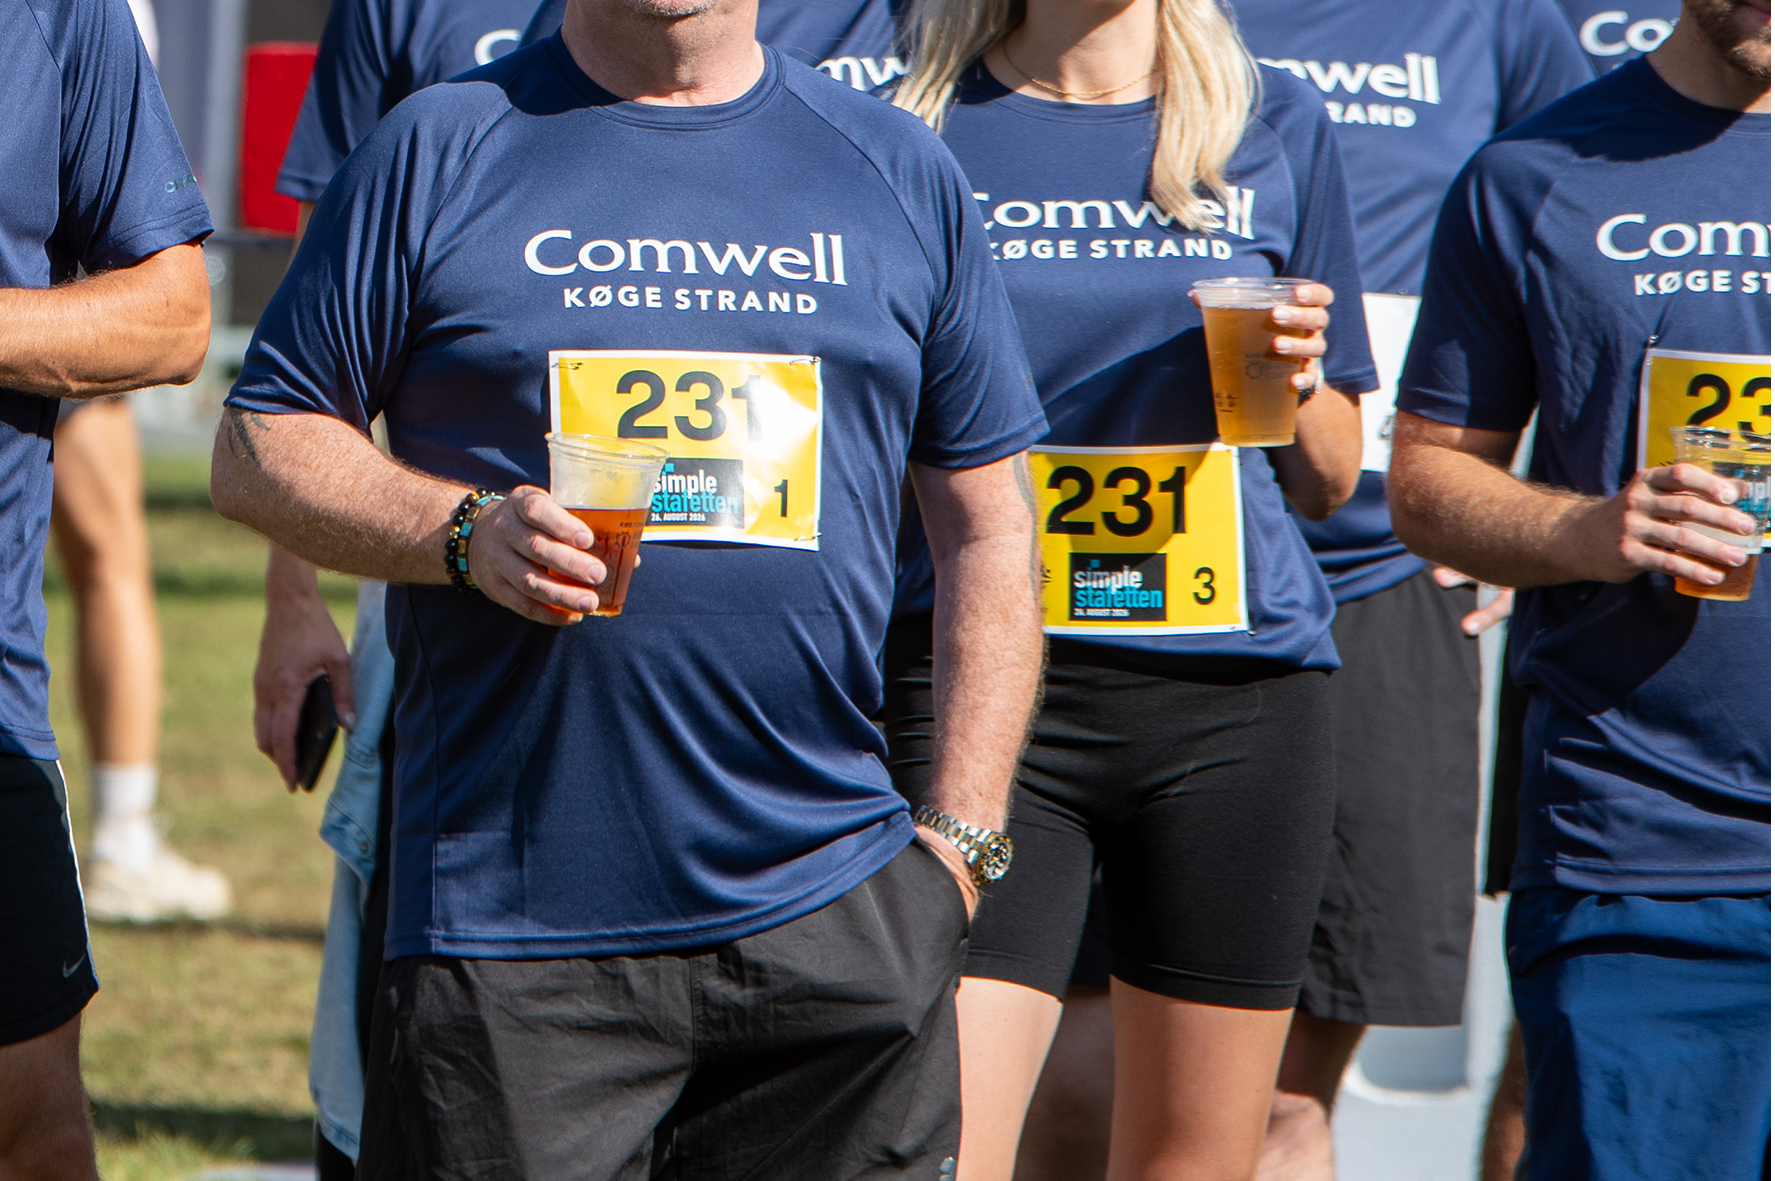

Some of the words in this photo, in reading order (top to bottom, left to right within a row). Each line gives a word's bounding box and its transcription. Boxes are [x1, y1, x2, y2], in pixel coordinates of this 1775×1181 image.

[1089, 238, 1233, 261] STRAND
[1596, 213, 1771, 261] Com
[524, 229, 848, 286] Comwell
[1634, 269, 1732, 296] KØGE
[563, 284, 663, 309] KØGE
[674, 288, 818, 315] STRAND
[615, 369, 762, 442] 231
[651, 490, 739, 514] stafetten
[773, 478, 789, 518] 1
[1045, 465, 1187, 538] 231
[663, 512, 688, 521] AUGUST
[1074, 565, 1143, 594] simple
[1192, 566, 1216, 605] 3
[1075, 586, 1163, 608] stafetten
